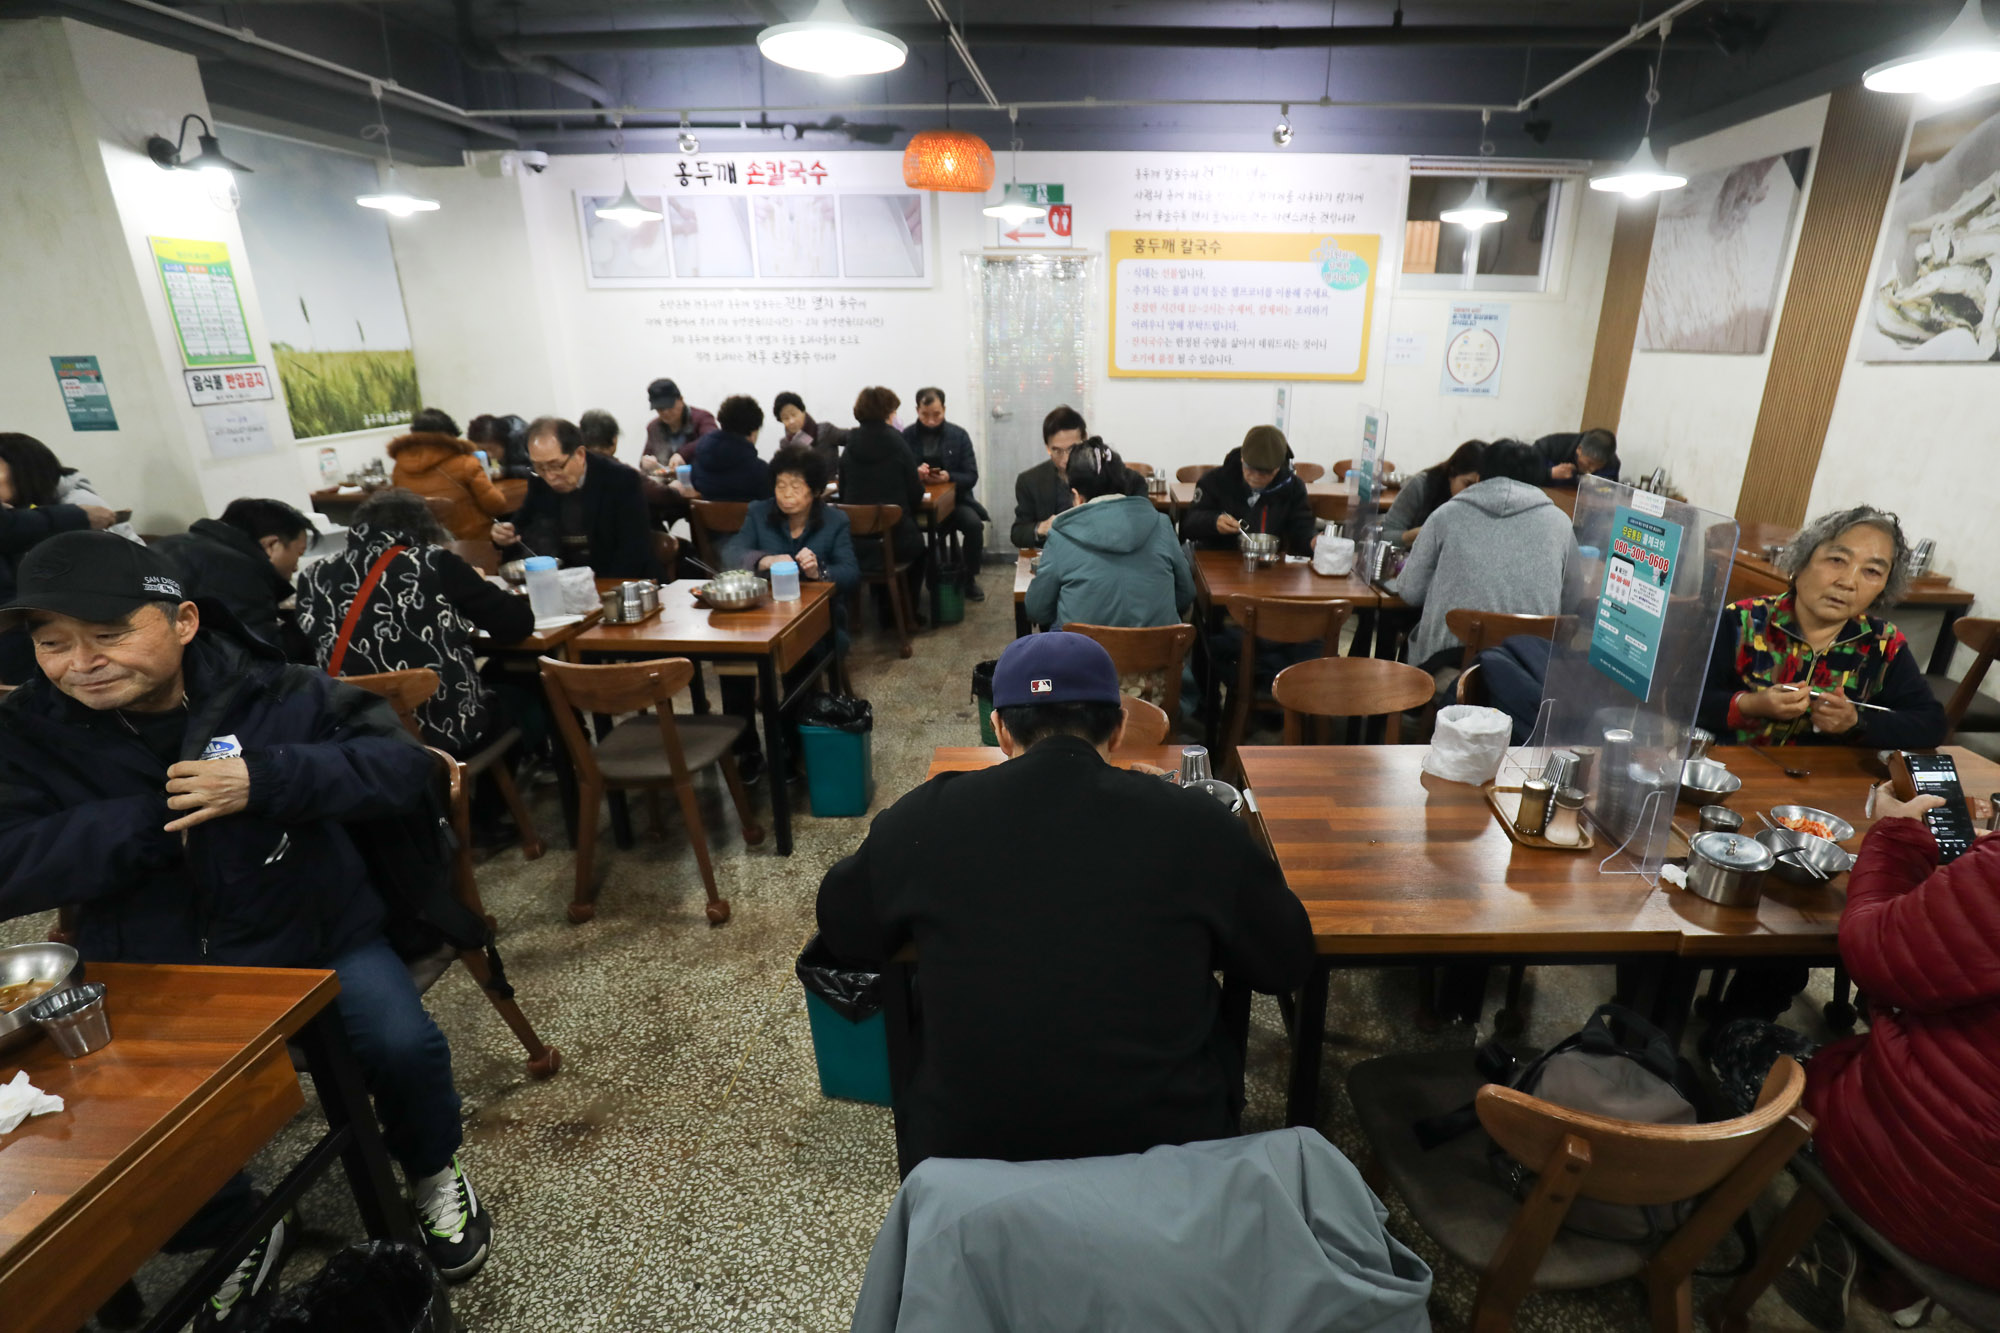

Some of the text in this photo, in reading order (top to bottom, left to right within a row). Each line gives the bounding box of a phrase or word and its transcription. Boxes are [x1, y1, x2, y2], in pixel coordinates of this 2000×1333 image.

[674, 160, 828, 186] 홍두깨 손칼국수
[1133, 238, 1222, 255] 홍두깨 칼국수
[1134, 267, 1206, 280] 식대는 선불입니다.
[1133, 285, 1149, 296] 추가
[1153, 285, 1168, 296] 되는
[1193, 286, 1208, 296] 김치
[1276, 287, 1301, 298] 이용해
[1133, 302, 1157, 313] 혼잡한
[1161, 302, 1185, 313] 시간대
[1295, 305, 1328, 316] 조리하기
[1132, 319, 1239, 332] 어려우니 양해 부탁드립니다.
[1132, 336, 1172, 347] 잔치국수는
[1176, 337, 1200, 348] 한정된
[1203, 337, 1226, 348] 수량을
[1232, 338, 1255, 349] 삶아서
[1303, 338, 1327, 350] 것이니
[1131, 353, 1155, 364] 조기에
[1158, 353, 1174, 364] 품절
[1188, 354, 1196, 364] 수
[1200, 354, 1234, 365] 있습니다.
[192, 372, 264, 392] 음식물 반입금지
[1622, 526, 1642, 542] 무료통화
[1642, 534, 1666, 551] 콜체크인
[1614, 539, 1670, 572] 080-300-0608
[161, 577, 180, 589] DIEGO
